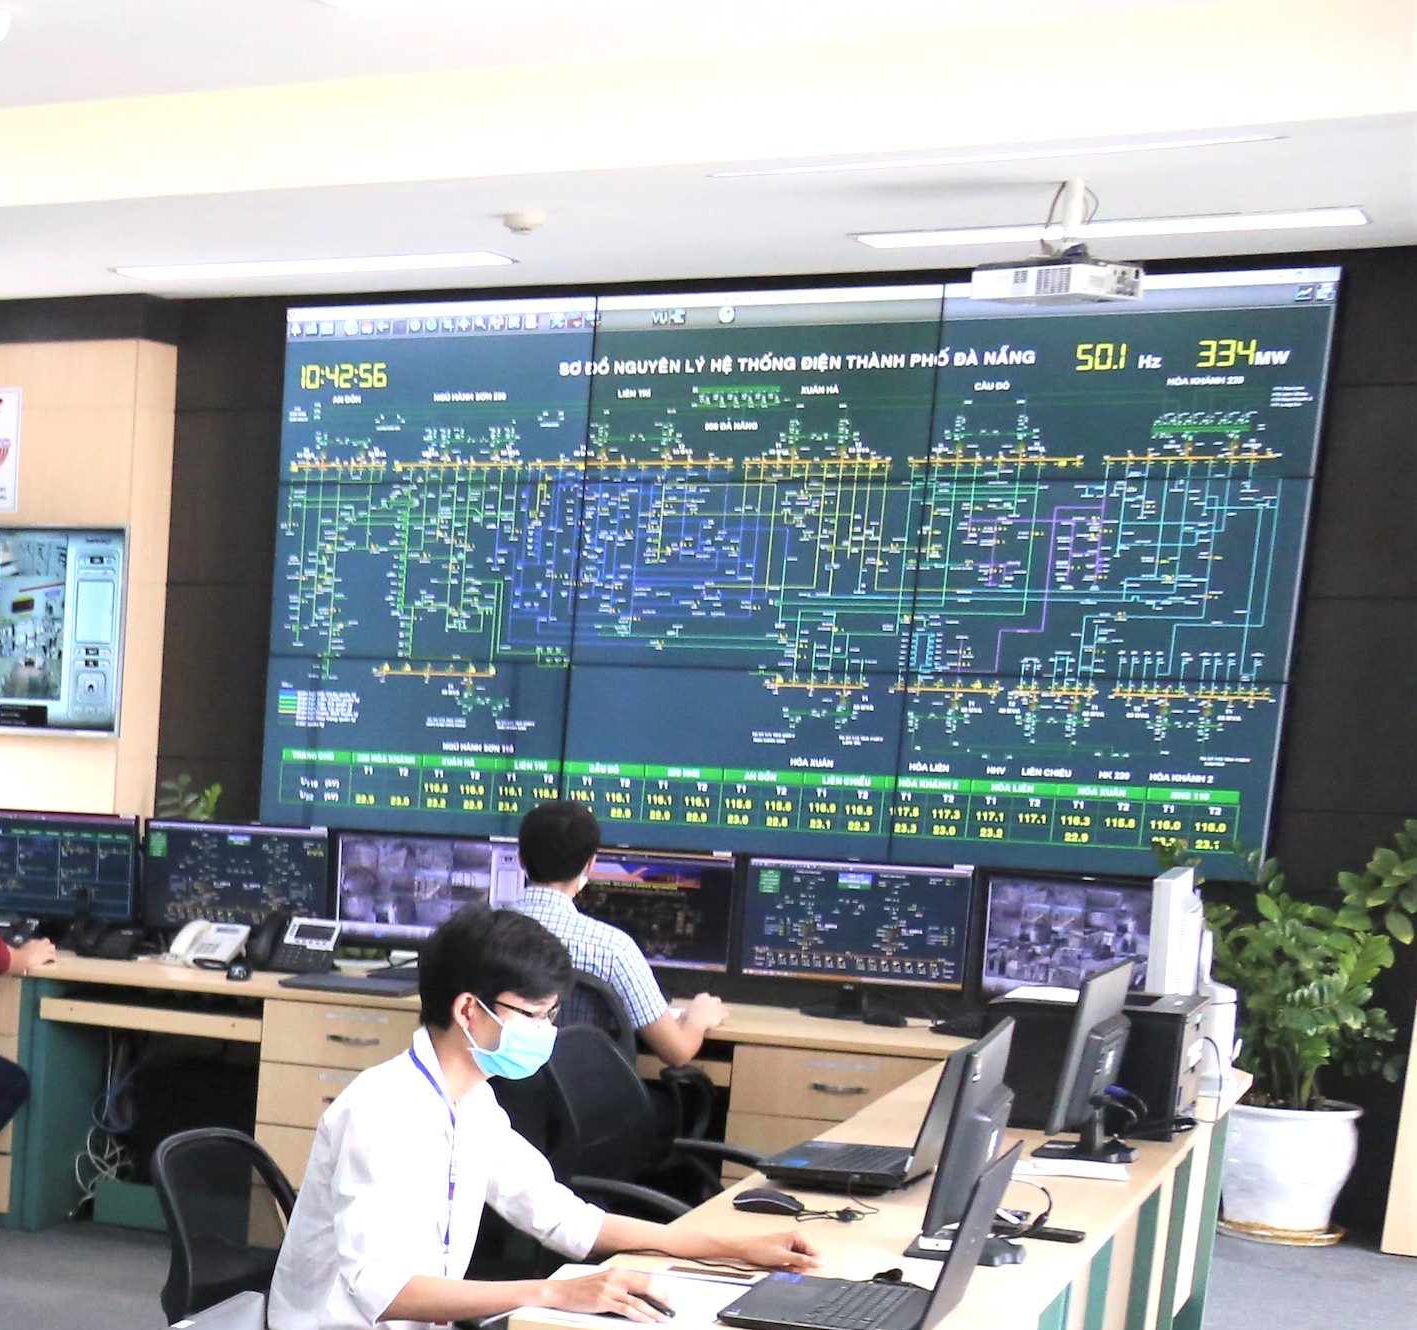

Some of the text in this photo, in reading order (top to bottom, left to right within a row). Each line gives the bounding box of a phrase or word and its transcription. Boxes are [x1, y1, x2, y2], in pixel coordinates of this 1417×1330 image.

[614, 356, 680, 375] NGUYÊN
[710, 355, 733, 375] HỆ
[738, 352, 796, 372] THỐNG
[801, 352, 842, 373] ĐIỆN
[846, 351, 906, 370] THÀNH
[910, 347, 950, 368] PHỐ
[953, 349, 979, 367] ĐÀ
[983, 345, 1036, 366] NẴNG
[1075, 343, 1162, 371] 50.1 Hz
[1196, 339, 1291, 368] 334 MW
[300, 362, 388, 389] 10:42:56
